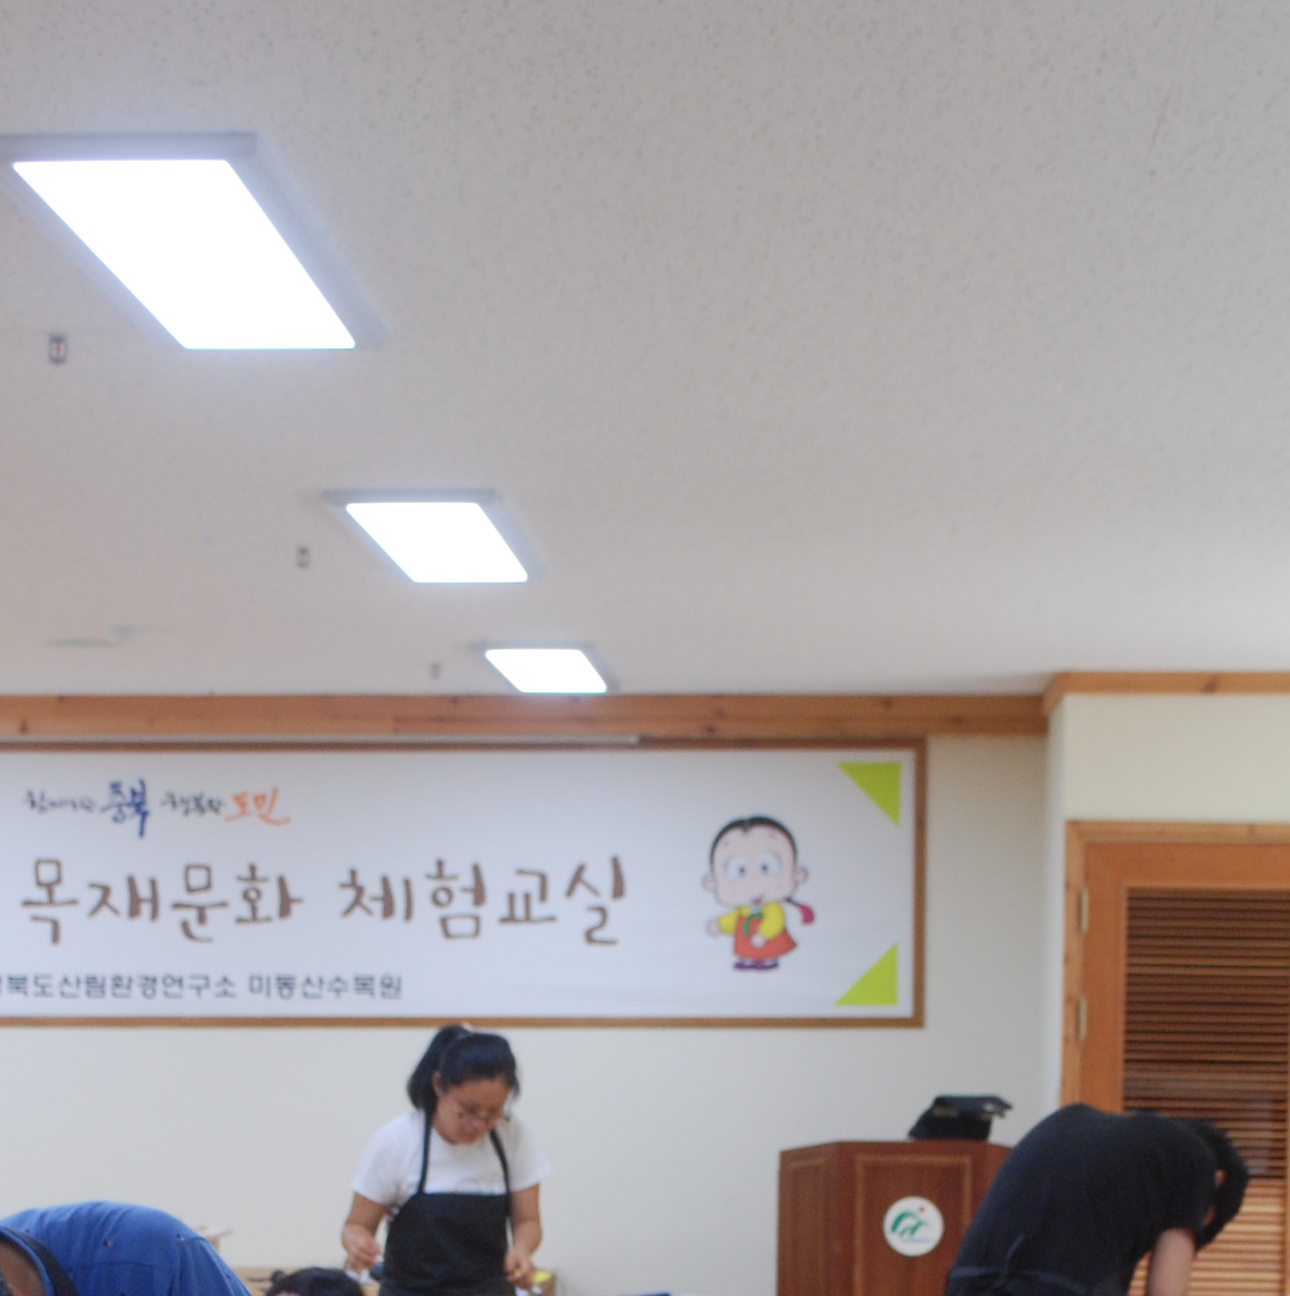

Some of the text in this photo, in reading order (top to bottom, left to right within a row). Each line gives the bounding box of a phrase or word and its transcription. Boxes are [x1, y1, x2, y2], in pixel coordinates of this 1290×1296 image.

[224, 786, 292, 826] 도민
[20, 857, 305, 946] 목재문화
[337, 853, 627, 947] 체험교실
[248, 972, 403, 1000] 미동산수목원
